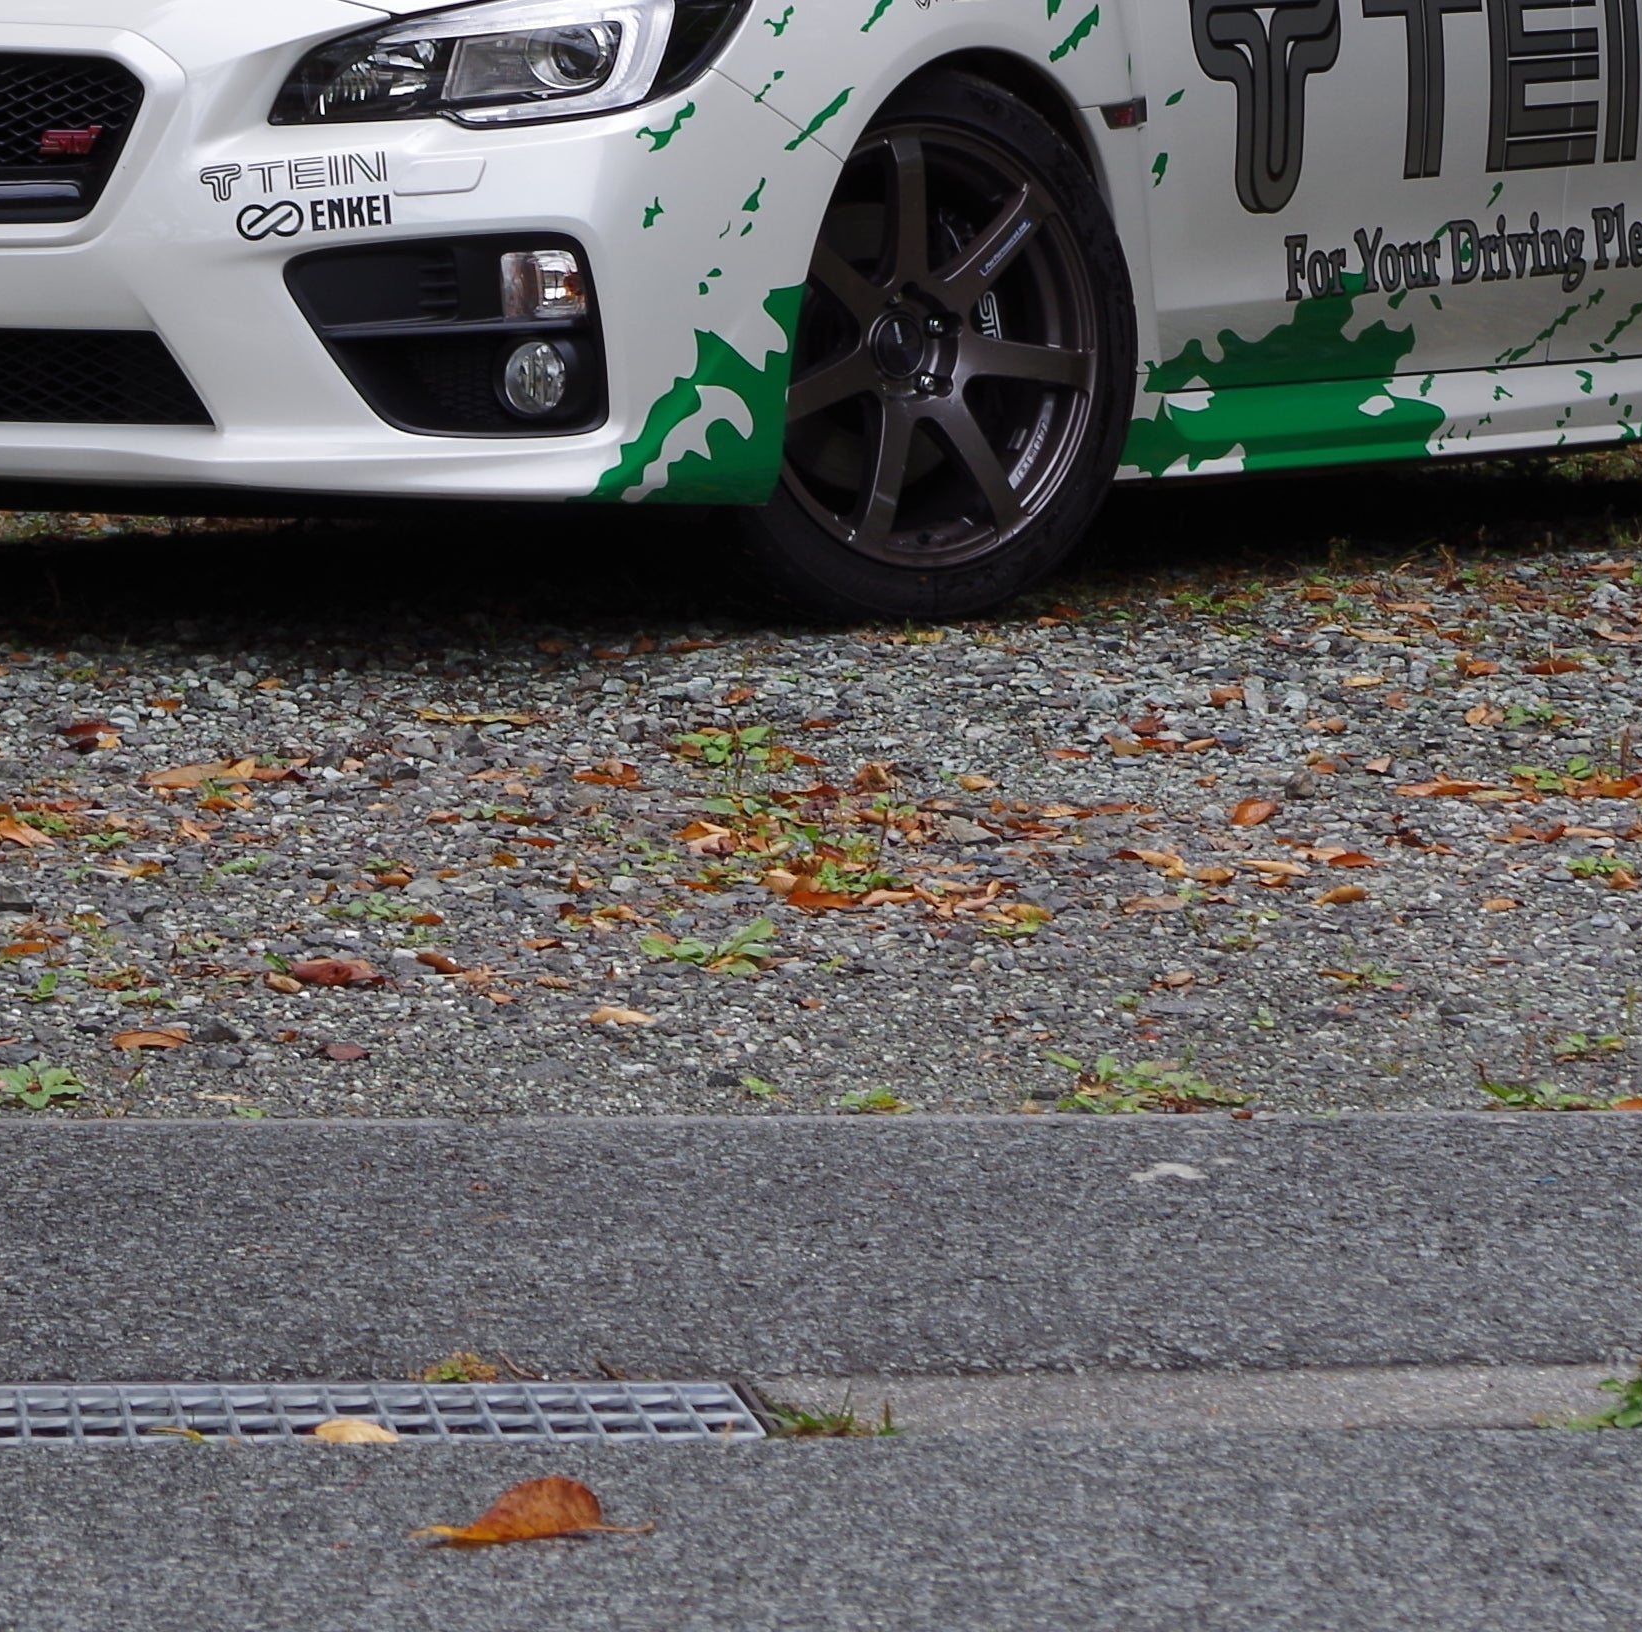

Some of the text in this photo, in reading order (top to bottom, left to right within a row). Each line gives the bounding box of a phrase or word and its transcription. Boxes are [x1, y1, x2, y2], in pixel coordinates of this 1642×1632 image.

[247, 151, 388, 194] TEIN
[310, 194, 392, 233] ENKEI
[1284, 233, 1347, 302] For
[1353, 226, 1442, 293] Your
[1448, 211, 1587, 293] Driving
